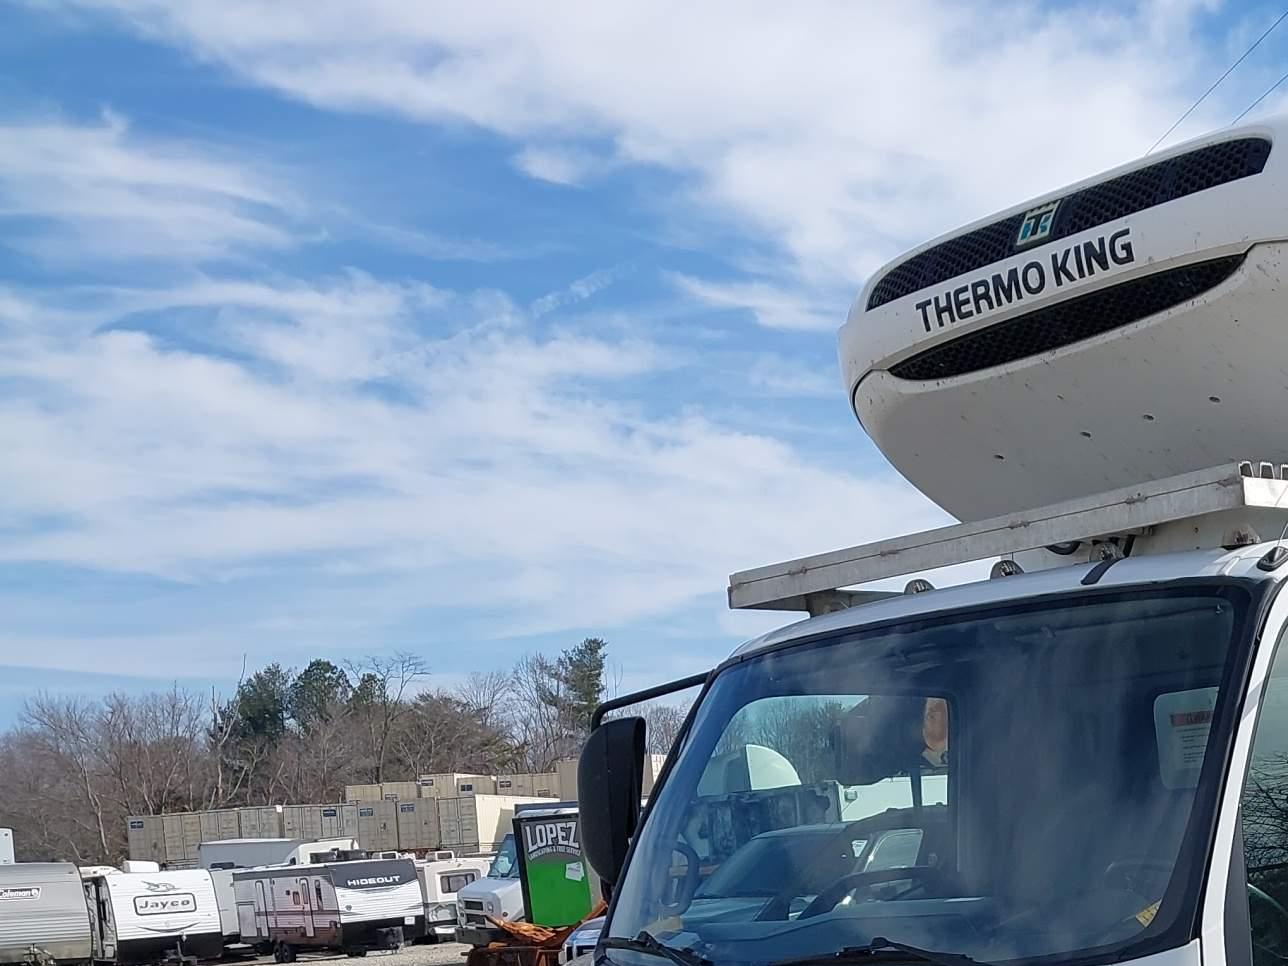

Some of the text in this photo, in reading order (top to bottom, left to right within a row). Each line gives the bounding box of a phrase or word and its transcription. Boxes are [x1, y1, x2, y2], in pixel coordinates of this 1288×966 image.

[915, 228, 1135, 333] THERMO KING
[525, 821, 580, 854] LOPEZ
[346, 875, 401, 886] HIDEOUT
[138, 899, 191, 910] Jayco
